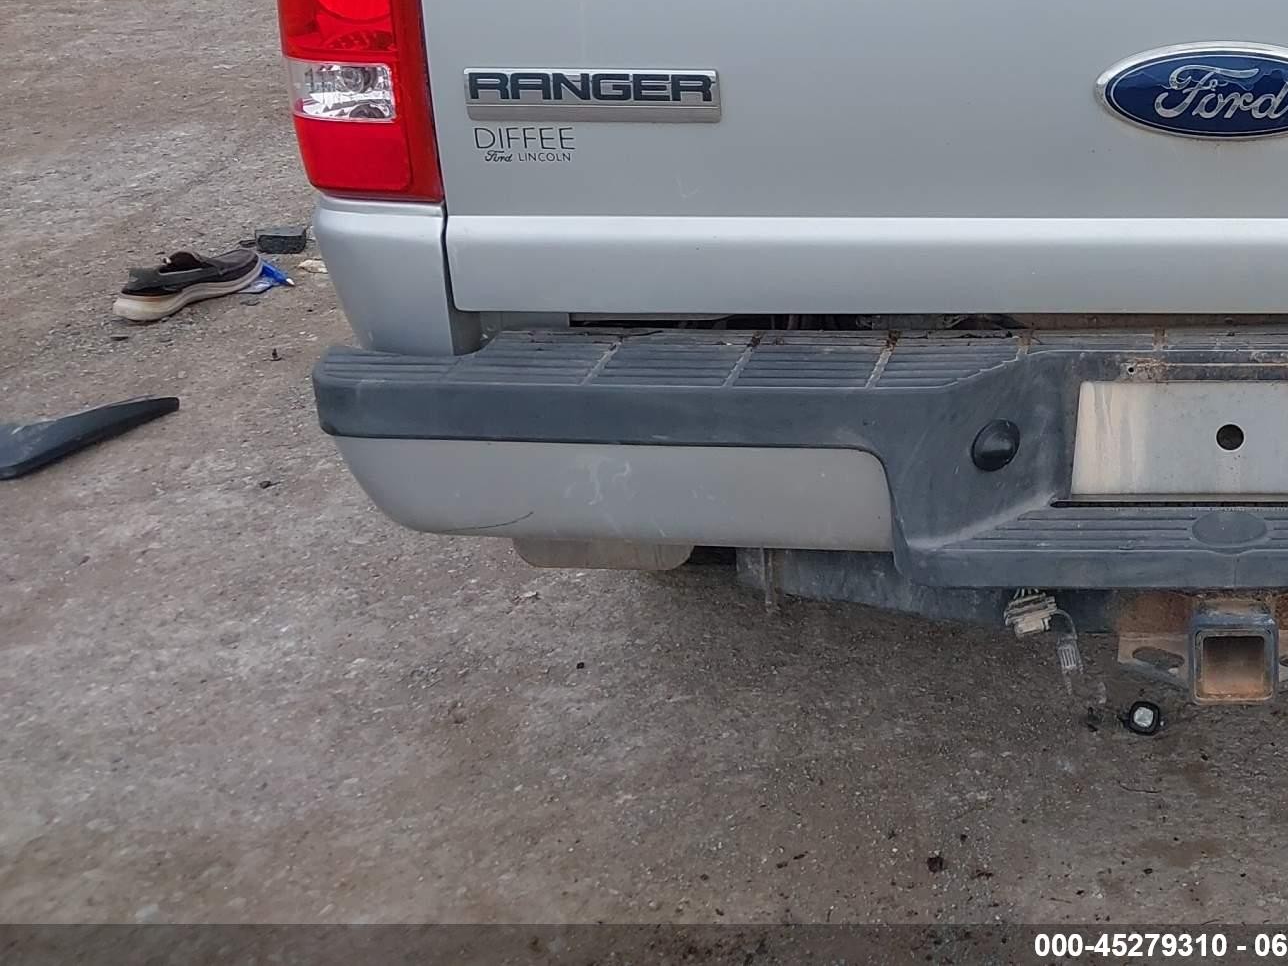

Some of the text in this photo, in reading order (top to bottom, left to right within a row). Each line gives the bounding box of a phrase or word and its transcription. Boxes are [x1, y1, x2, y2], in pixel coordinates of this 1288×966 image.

[468, 72, 713, 102] RANGER
[474, 127, 576, 150] DIFFEE
[484, 150, 571, 162] Ford LINCOLN
